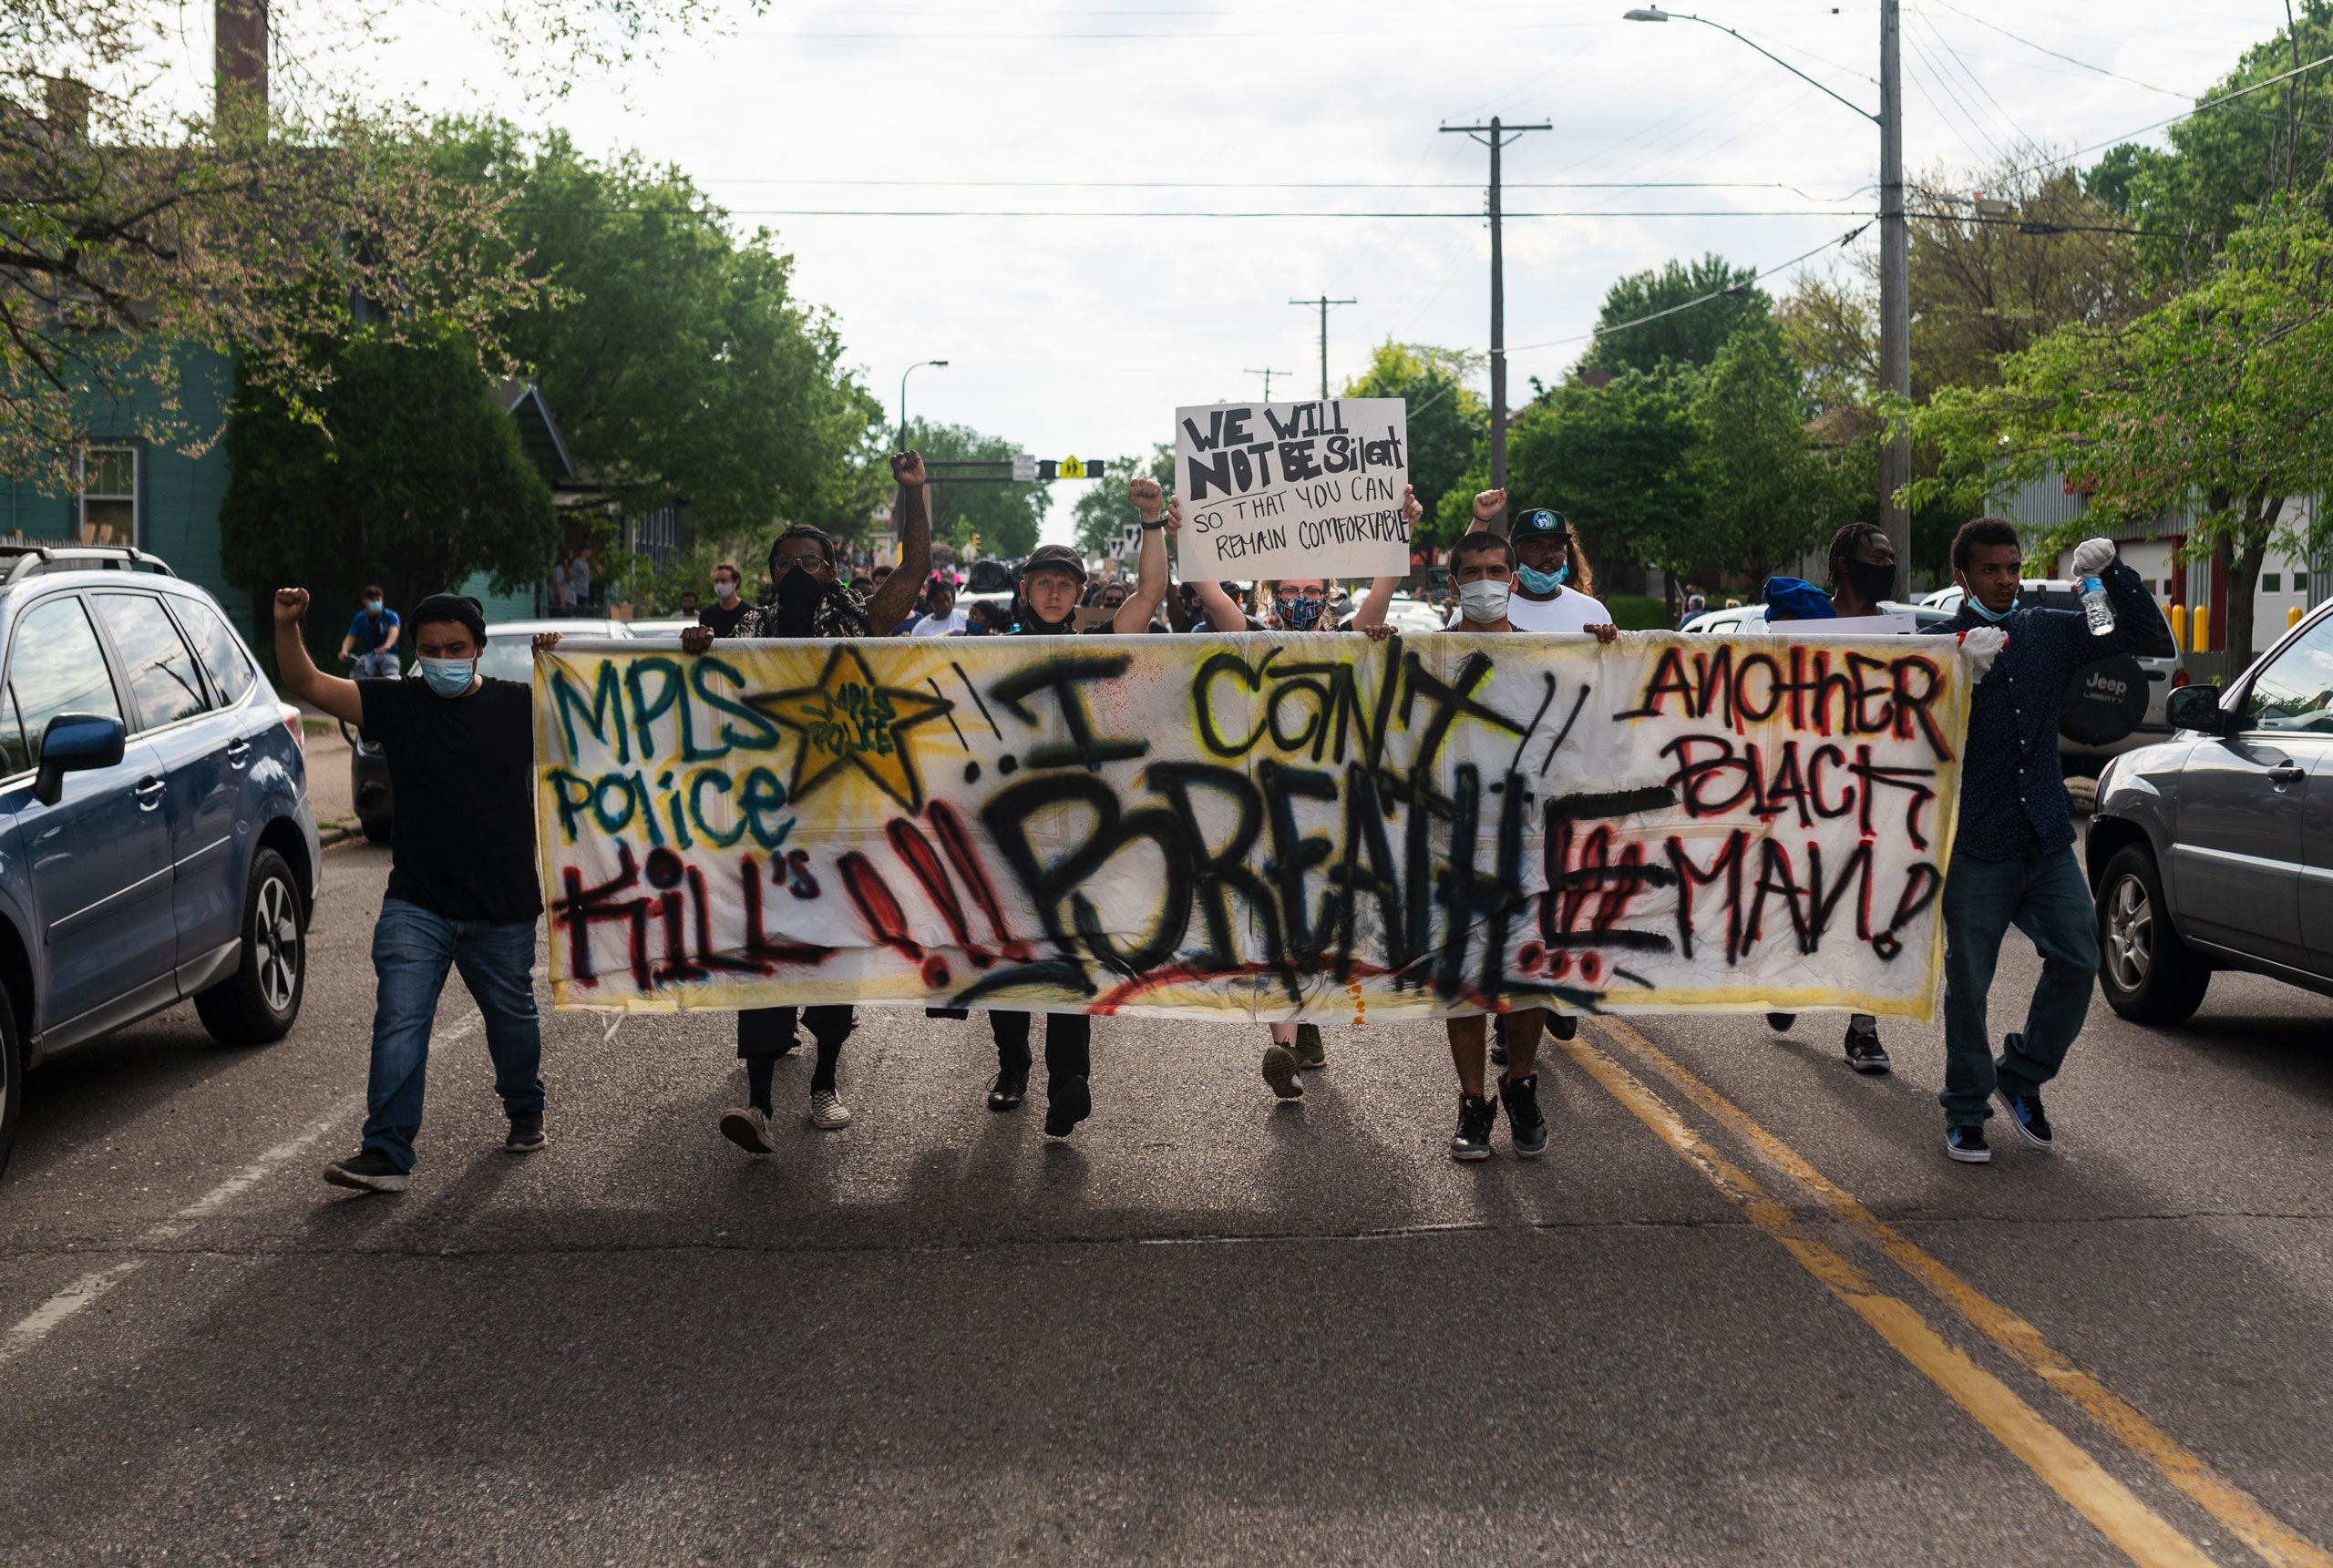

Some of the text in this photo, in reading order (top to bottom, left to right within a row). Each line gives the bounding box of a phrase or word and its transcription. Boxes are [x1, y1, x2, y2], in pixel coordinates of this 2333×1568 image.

[1182, 401, 1349, 453] WE WILL
[1187, 441, 1274, 501] NOT
[1278, 439, 1322, 482] BE
[1193, 477, 1393, 533] SO THAT YOU CAN
[1216, 507, 1410, 561] REMAIN COMFORTABLE
[550, 656, 781, 766] MPLS
[801, 682, 897, 723] MPLS
[2083, 691, 2125, 705] LIBERTY
[2086, 672, 2127, 696] Jeep
[808, 717, 894, 757] POLICE
[987, 652, 1150, 771] I
[1660, 733, 1936, 851] BLACK
